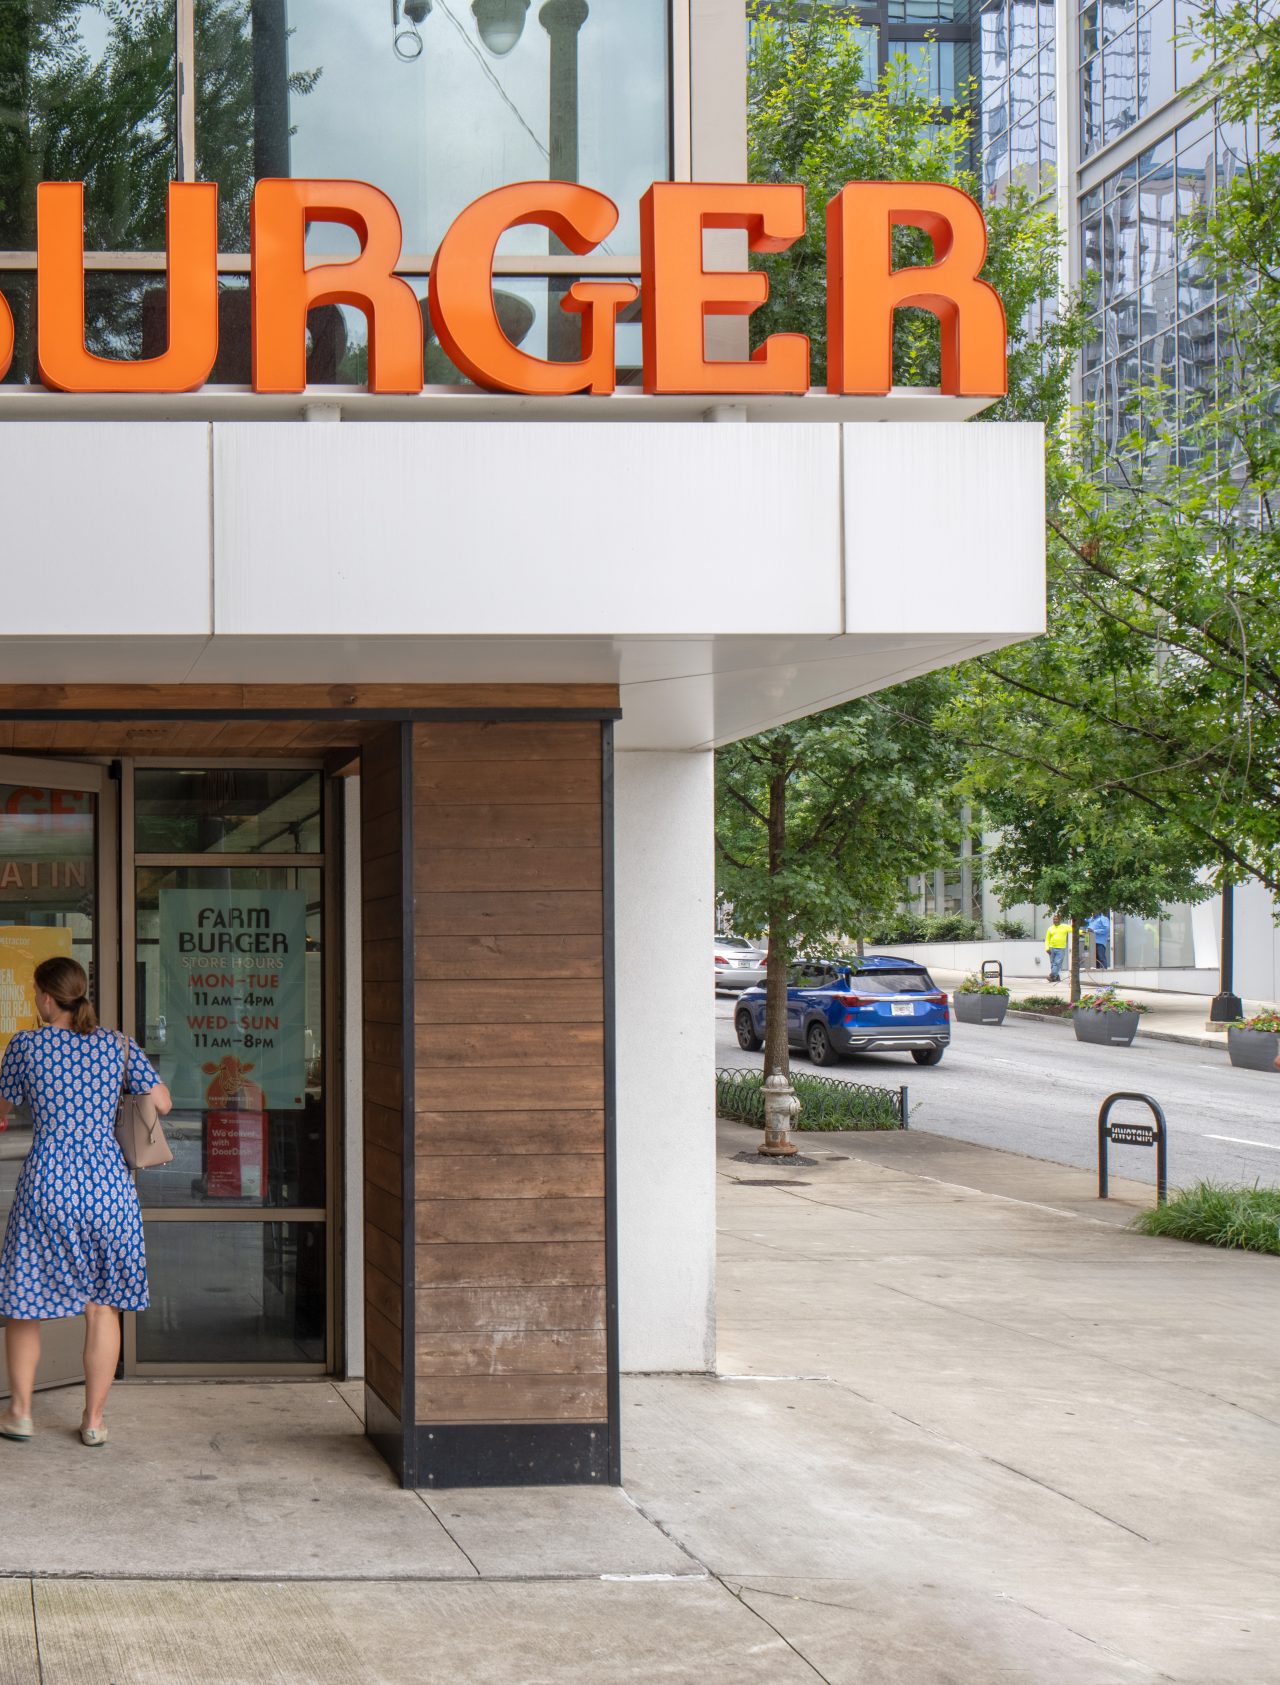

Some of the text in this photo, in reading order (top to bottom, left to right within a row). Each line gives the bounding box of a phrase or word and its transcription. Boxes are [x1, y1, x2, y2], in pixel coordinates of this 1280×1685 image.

[198, 907, 270, 929] FARM
[179, 932, 289, 954] BURGER
[182, 956, 284, 969] STORE HOURS
[13, 1000, 32, 1017] REAL
[211, 1129, 227, 1137] We
[211, 1138, 230, 1147] with
[212, 1147, 253, 1156] DoorDash
